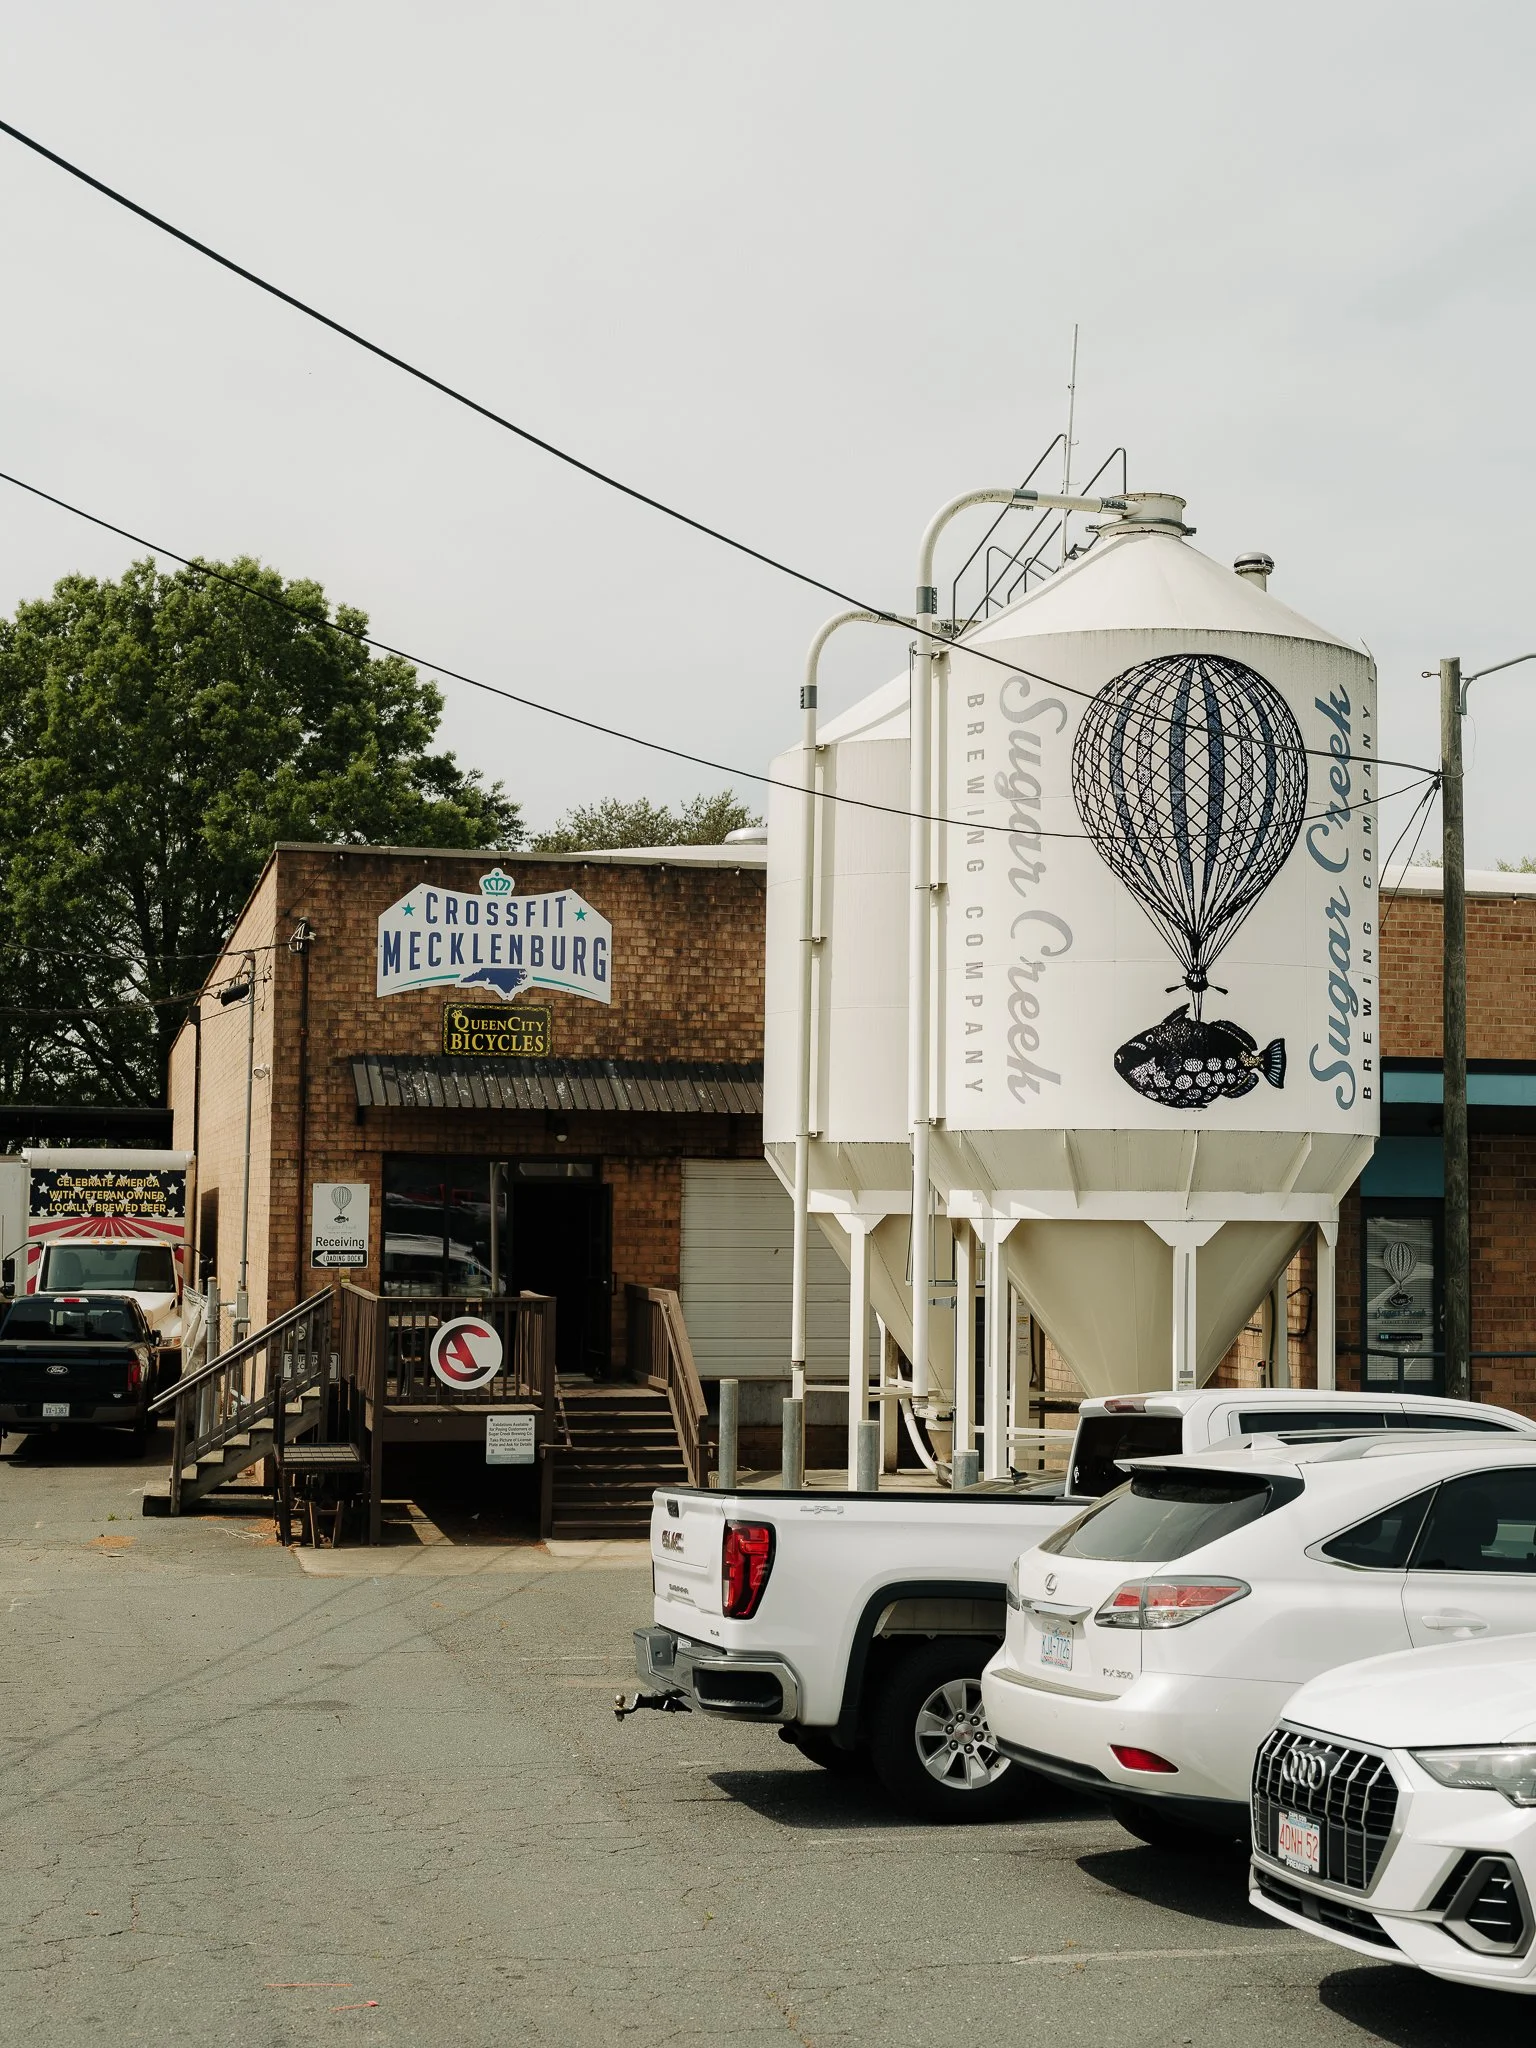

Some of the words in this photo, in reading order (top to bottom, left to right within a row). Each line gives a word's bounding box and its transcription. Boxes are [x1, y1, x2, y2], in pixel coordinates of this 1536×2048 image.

[966, 693, 985, 873] BREWING
[994, 675, 1067, 898] Sugar
[1306, 684, 1351, 873] Creek
[1363, 705, 1372, 889] COMPANY
[425, 892, 567, 928] CROSSFIT
[382, 930, 607, 983] MECKLENBURG
[965, 906, 983, 1092] COMPANY
[1007, 910, 1073, 1104] Creek
[1309, 885, 1358, 1110] Sugar
[1363, 922, 1372, 1099] BREWING
[450, 1032, 545, 1053] BICYCLES
[49, 1190, 76, 1200] WITH
[78, 1190, 124, 1200] VETERAN
[126, 1191, 167, 1201] OWNED,
[56, 1178, 113, 1187] CELEBRATE
[115, 1178, 160, 1188] AMERICA
[49, 1203, 93, 1212] LOCALLY
[95, 1203, 138, 1212] BREWED
[140, 1203, 166, 1213] BEER
[315, 1236, 365, 1249] Receiving
[661, 1529, 684, 1553] GMC
[1279, 1823, 1303, 1857] 4DNH
[1306, 1832, 1319, 1862] 52
[1286, 1858, 1310, 1874] PREMIER
